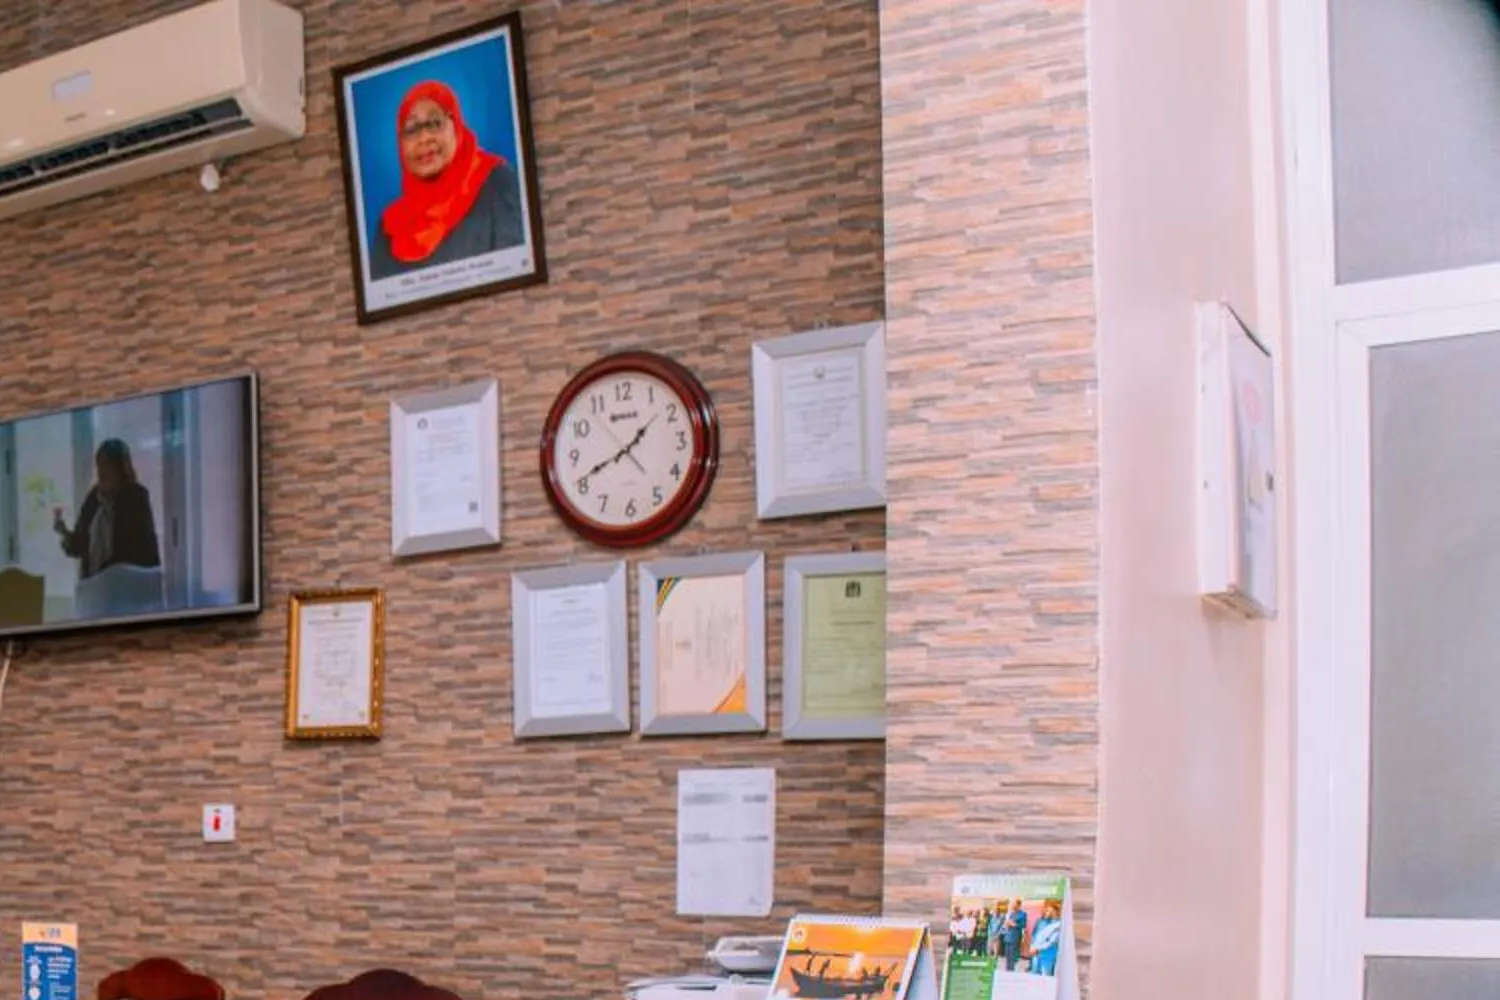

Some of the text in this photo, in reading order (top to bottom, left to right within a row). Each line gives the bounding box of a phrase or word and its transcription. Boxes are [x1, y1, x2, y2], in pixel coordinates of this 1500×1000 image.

[615, 381, 632, 401] 12
[591, 394, 605, 415] 11
[666, 404, 678, 423] 2
[573, 418, 590, 438] 10
[676, 431, 687, 450] 3
[569, 449, 580, 466] 9
[669, 463, 680, 480] 4
[578, 477, 589, 494] 8
[598, 494, 608, 512] 7
[652, 486, 663, 506] 5
[625, 498, 636, 517] 6
